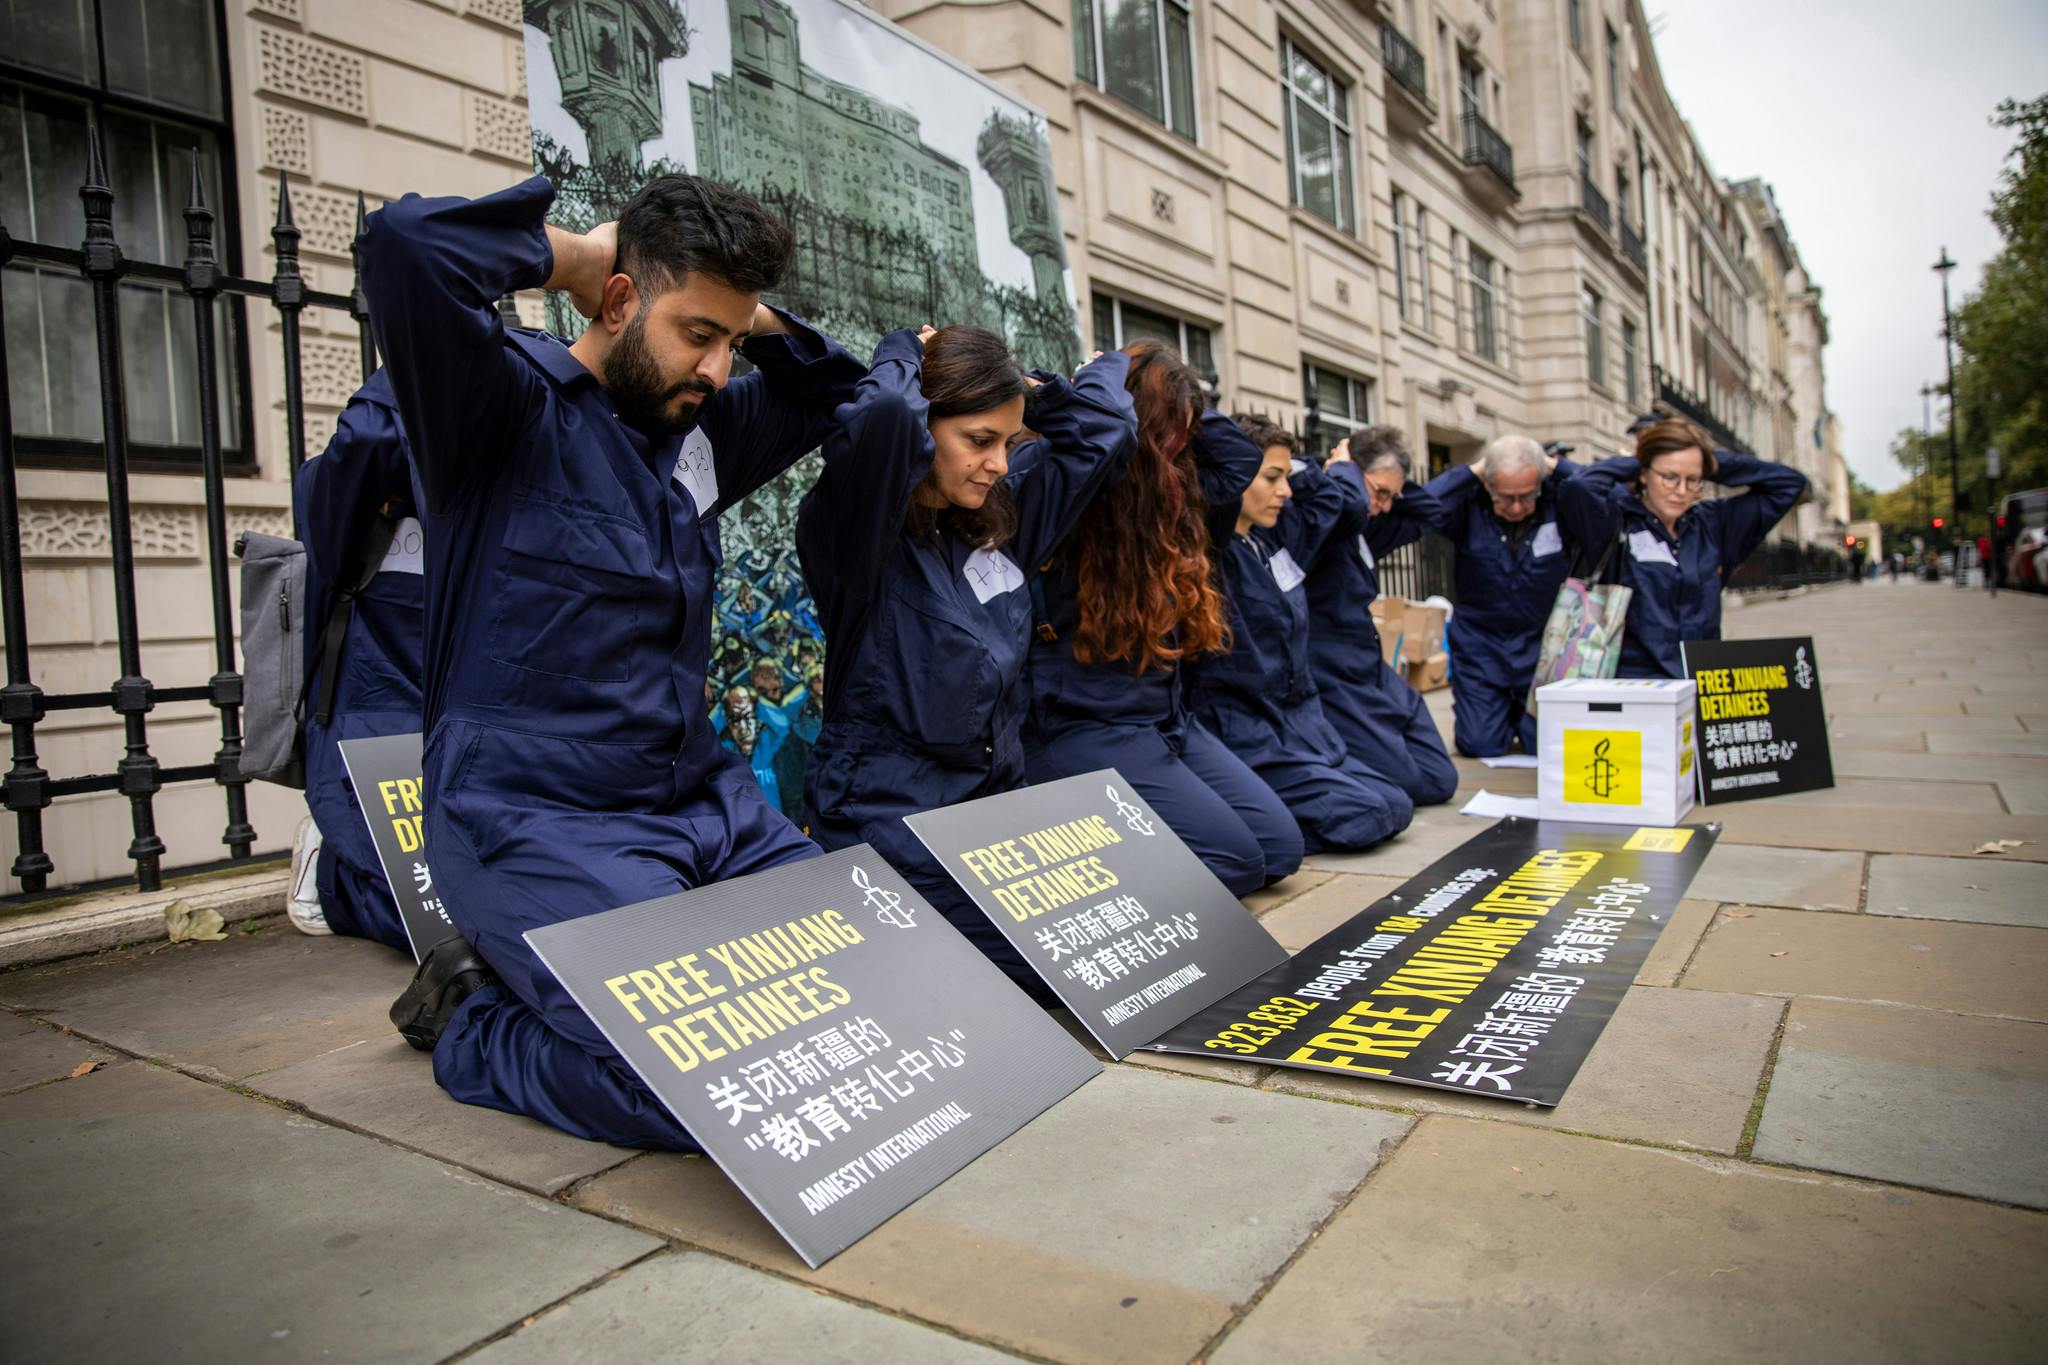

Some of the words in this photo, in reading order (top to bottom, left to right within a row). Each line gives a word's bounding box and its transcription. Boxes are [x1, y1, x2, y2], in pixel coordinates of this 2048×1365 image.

[1696, 669, 1732, 695] FREE
[1732, 664, 1789, 692] XINJIANG
[1700, 691, 1771, 721] DETAINEES
[391, 815, 424, 853] D
[960, 839, 1038, 886] FREE
[1019, 815, 1123, 867] XINJIANG
[991, 855, 1120, 922] DETAINEES
[1034, 894, 1150, 962] 关闭新疆的
[1285, 1000, 1452, 1075] FREE
[1370, 915, 1540, 1004] XINJIANG
[1471, 849, 1605, 916] DETAINEES
[604, 953, 728, 1024] FREE
[705, 909, 865, 987] XINJIANG
[1101, 992, 1149, 1027] AMNESTY
[1140, 963, 1207, 1006] INTERNATIONAL
[1204, 996, 1321, 1054] 323,832
[1294, 960, 1372, 1001] people
[1340, 934, 1407, 959] from
[1374, 916, 1430, 933] 184
[1407, 881, 1476, 917] countries
[646, 966, 851, 1073] DETAINEES
[705, 1015, 893, 1127] 关闭新疆的
[798, 1156, 876, 1216] AMNESTY
[866, 1101, 972, 1172] INTERNATIONAL
